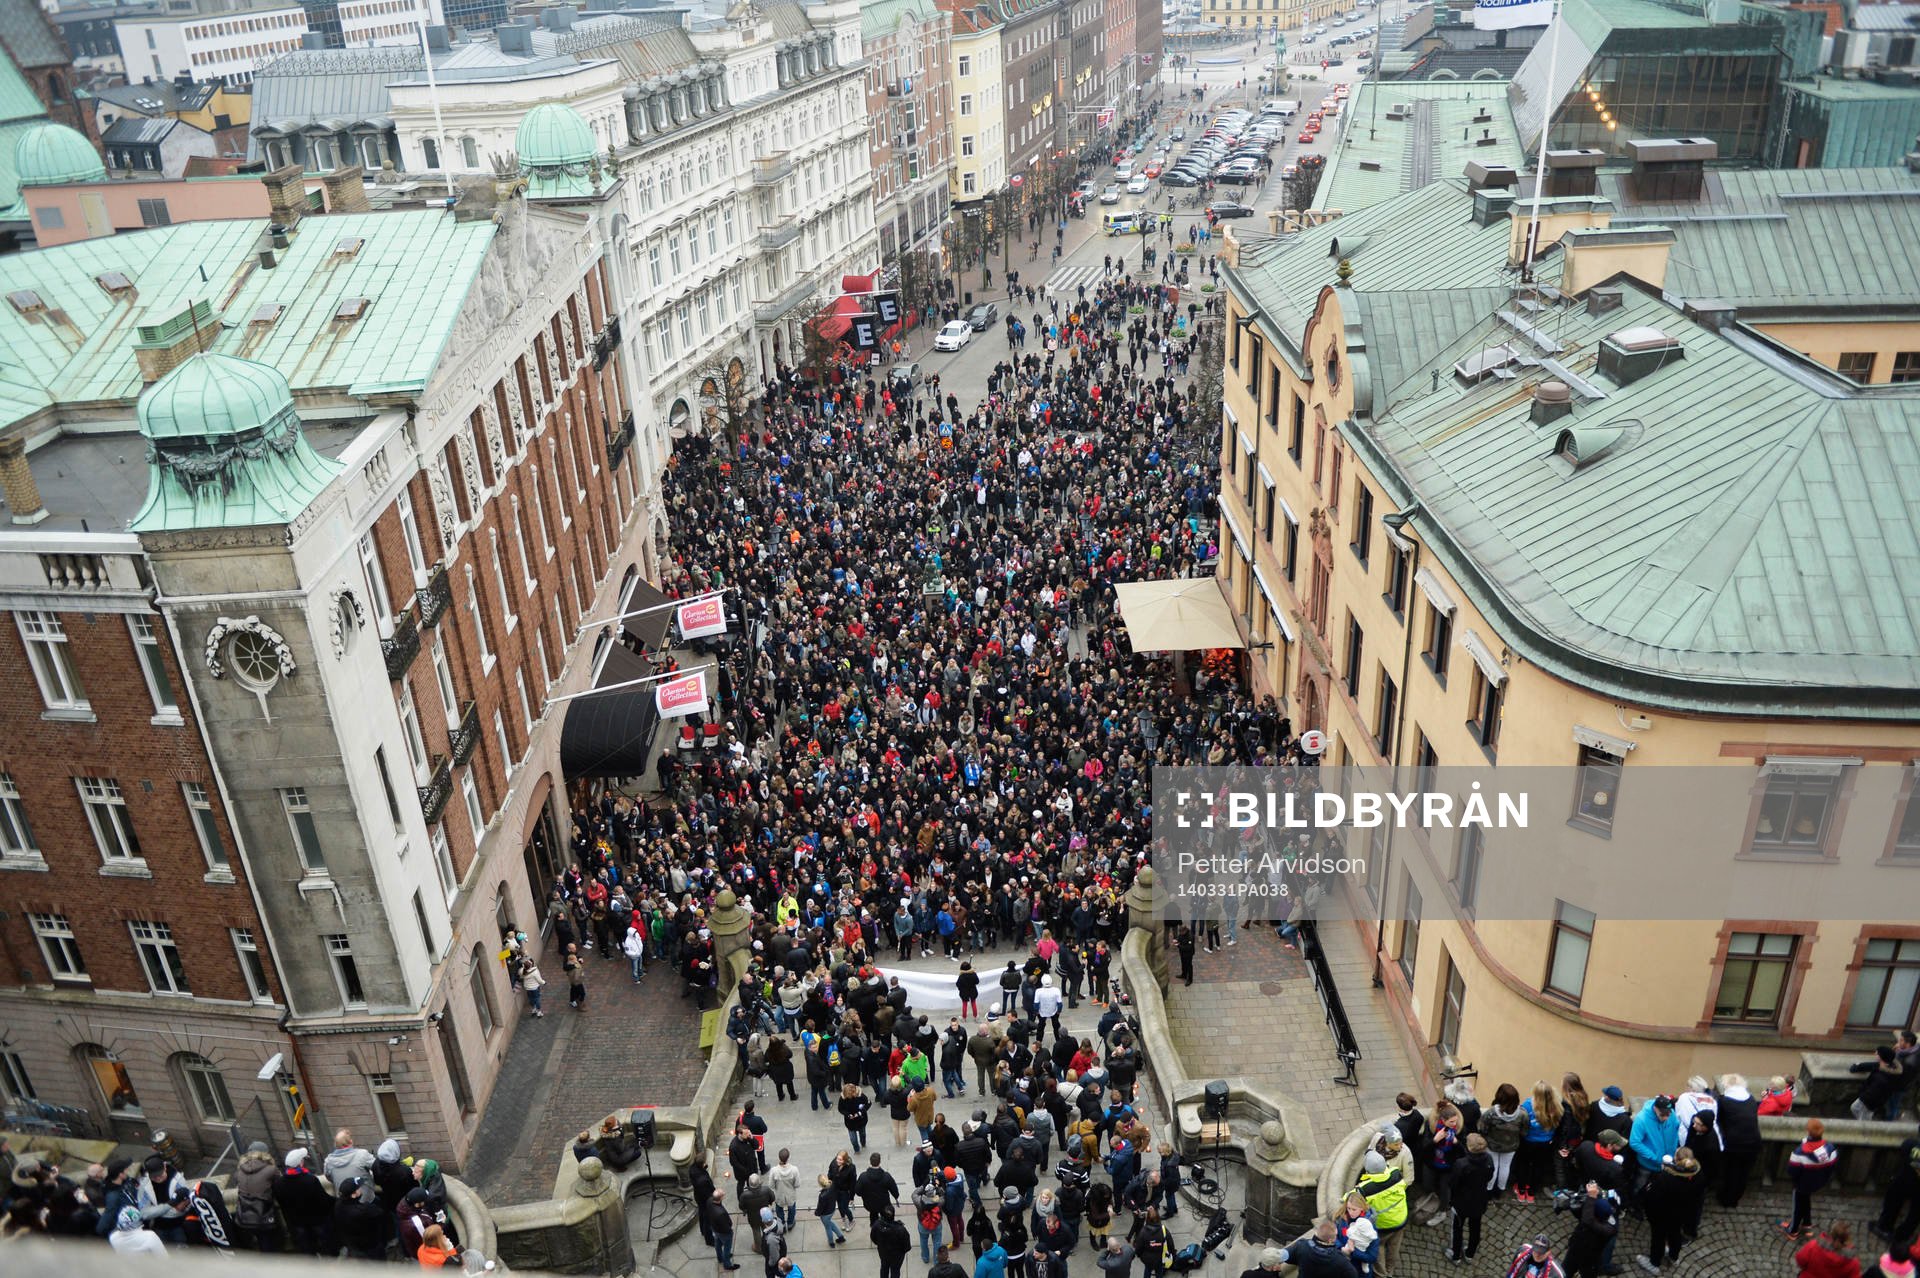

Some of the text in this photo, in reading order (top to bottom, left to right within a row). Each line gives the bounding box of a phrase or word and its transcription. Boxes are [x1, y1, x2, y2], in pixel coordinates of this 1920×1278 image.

[880, 300, 898, 322] E
[856, 323, 874, 346] E
[683, 608, 706, 620] Clarion
[689, 612, 718, 624] Collection
[662, 686, 686, 698] Clarion
[668, 690, 699, 702] Collection
